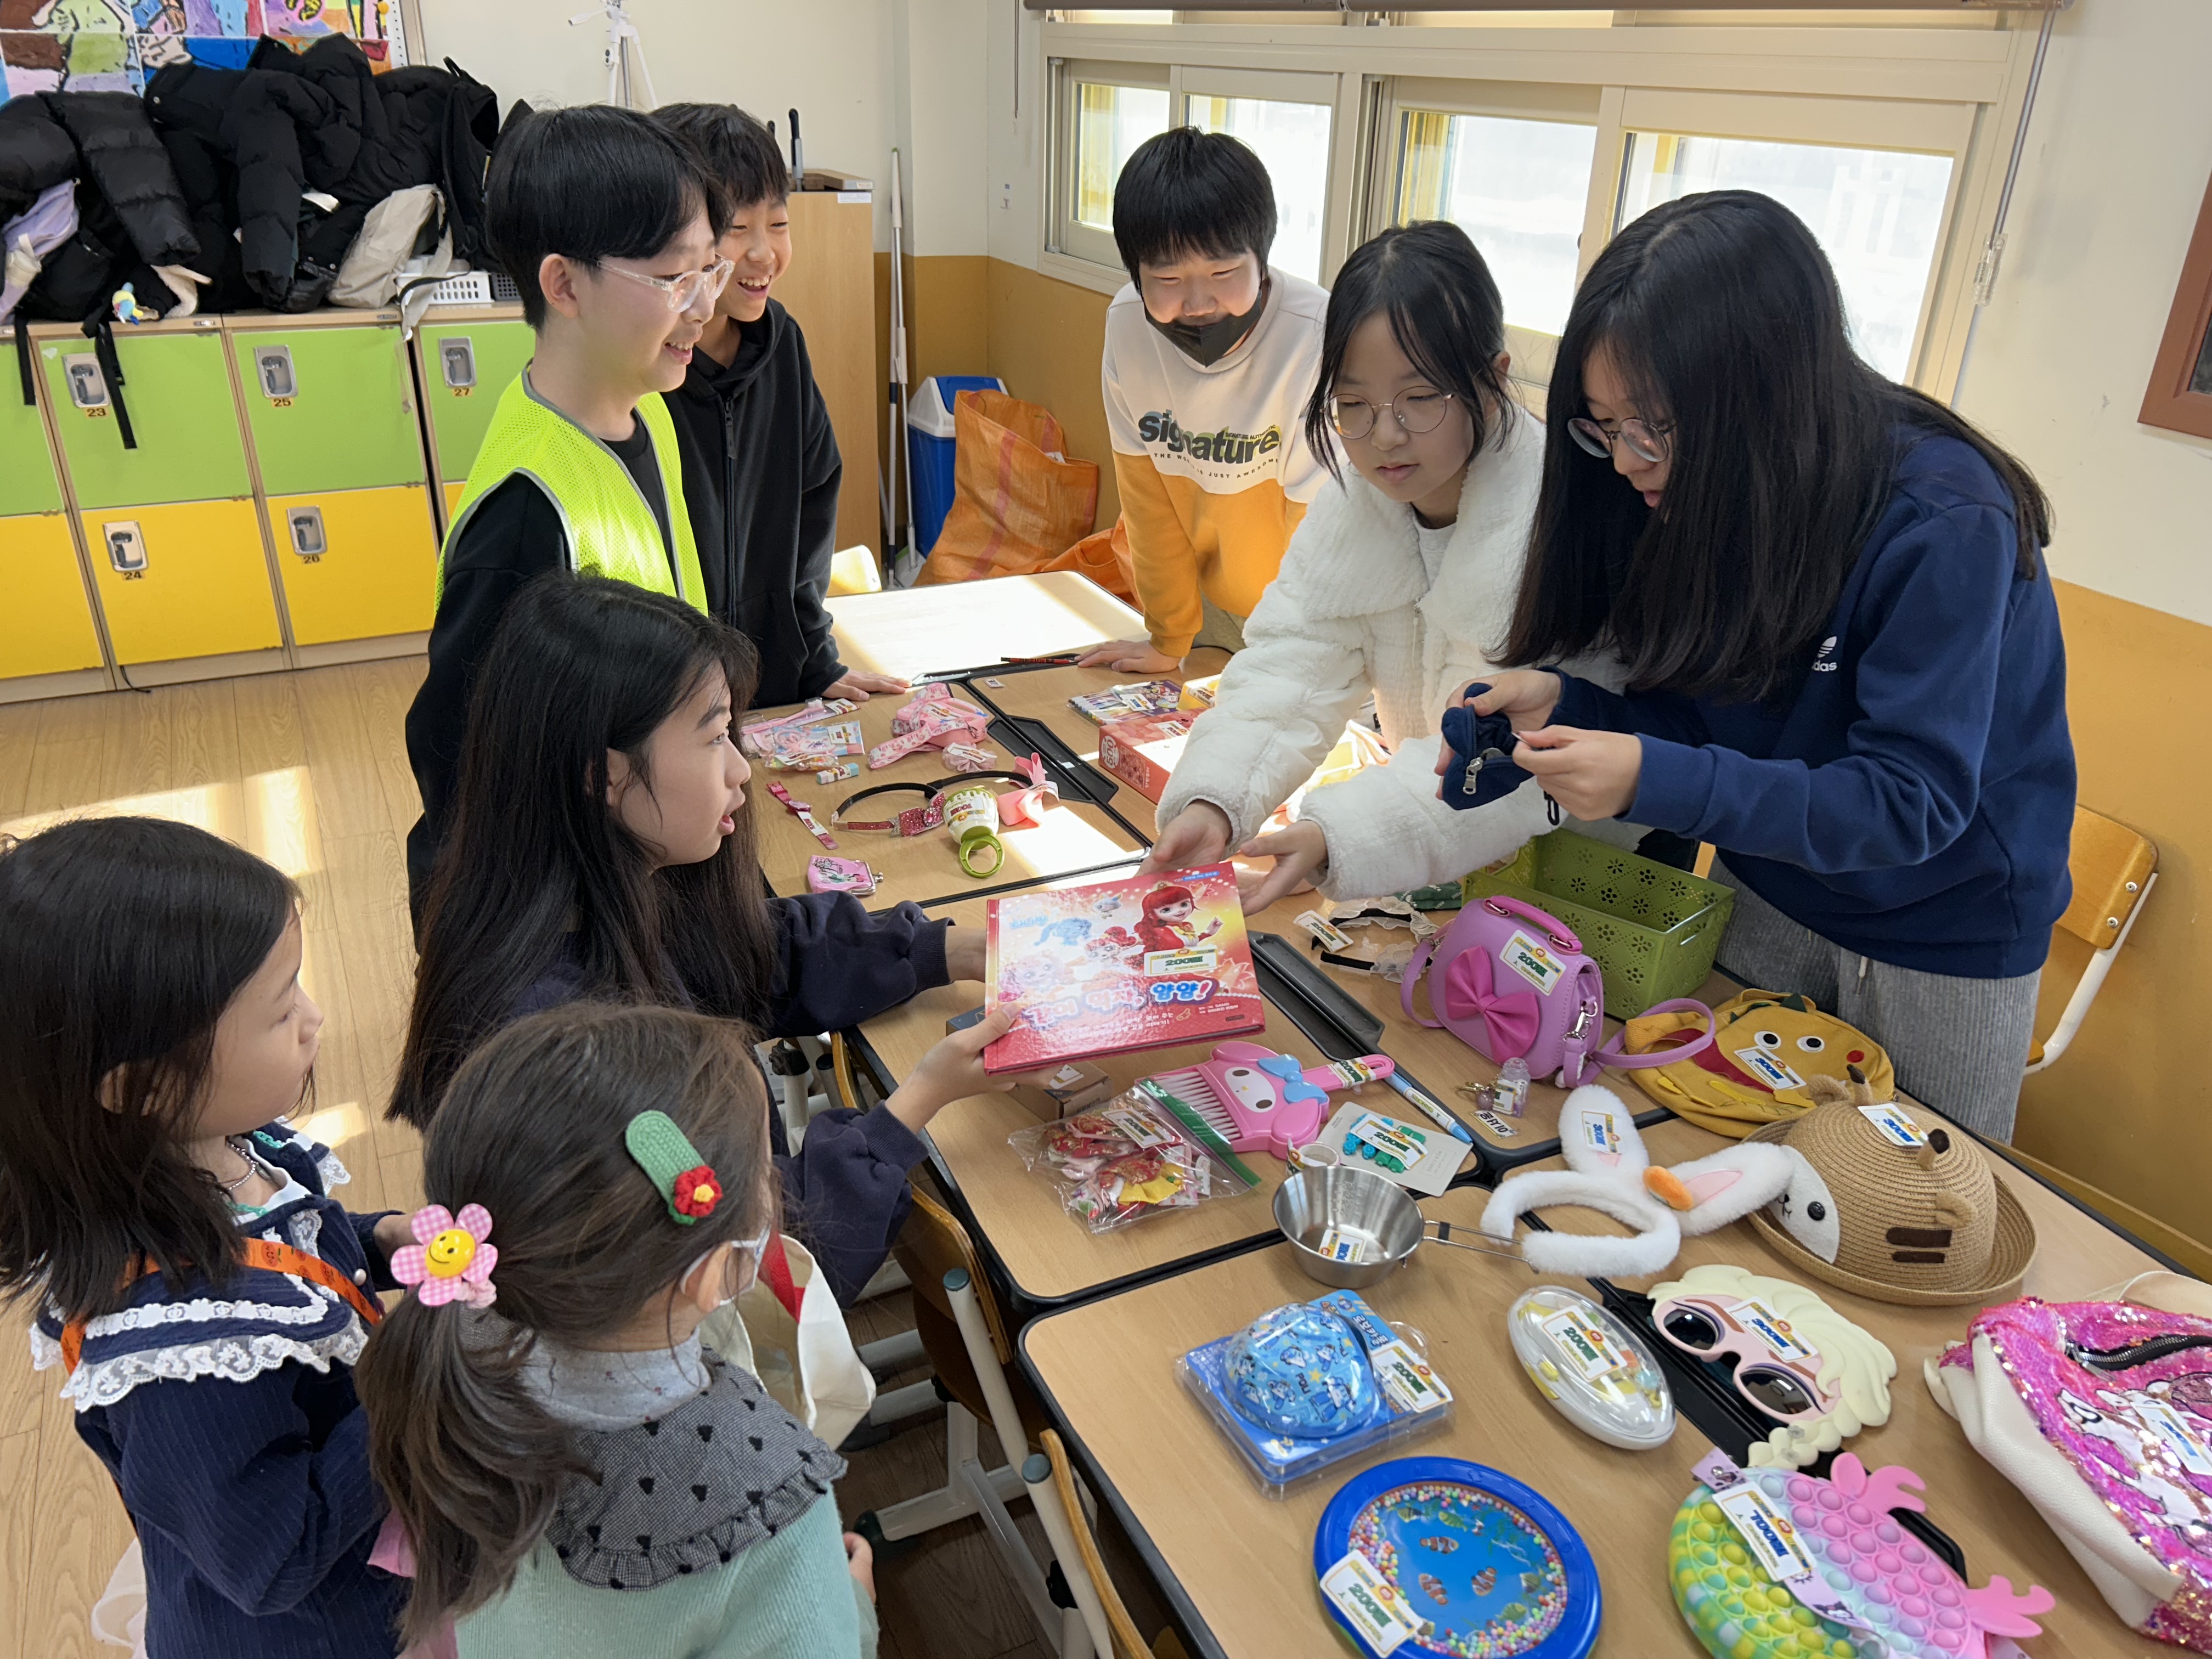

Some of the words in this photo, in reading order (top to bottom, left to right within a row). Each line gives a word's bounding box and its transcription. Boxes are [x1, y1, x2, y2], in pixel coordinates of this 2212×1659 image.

[87, 408, 107, 417] 23
[274, 398, 291, 407] 25
[1138, 411, 1280, 464] signature
[303, 555, 320, 563] 26
[124, 571, 142, 579] 24
[1165, 956, 1203, 966] 200원
[1518, 952, 1548, 977] 200원
[1153, 981, 1210, 1001] 얌얌!
[1755, 1058, 1784, 1079] 300원
[1374, 1131, 1410, 1152] 200원
[1883, 1118, 1916, 1142] 300원
[1352, 1313, 1389, 1347] 로보카폴
[1751, 1318, 1791, 1347] 300원
[1563, 1327, 1599, 1362] 200원
[1295, 1372, 1312, 1395] POLI
[1391, 1361, 1428, 1394] 200원
[1348, 1583, 1392, 1628] 200원
